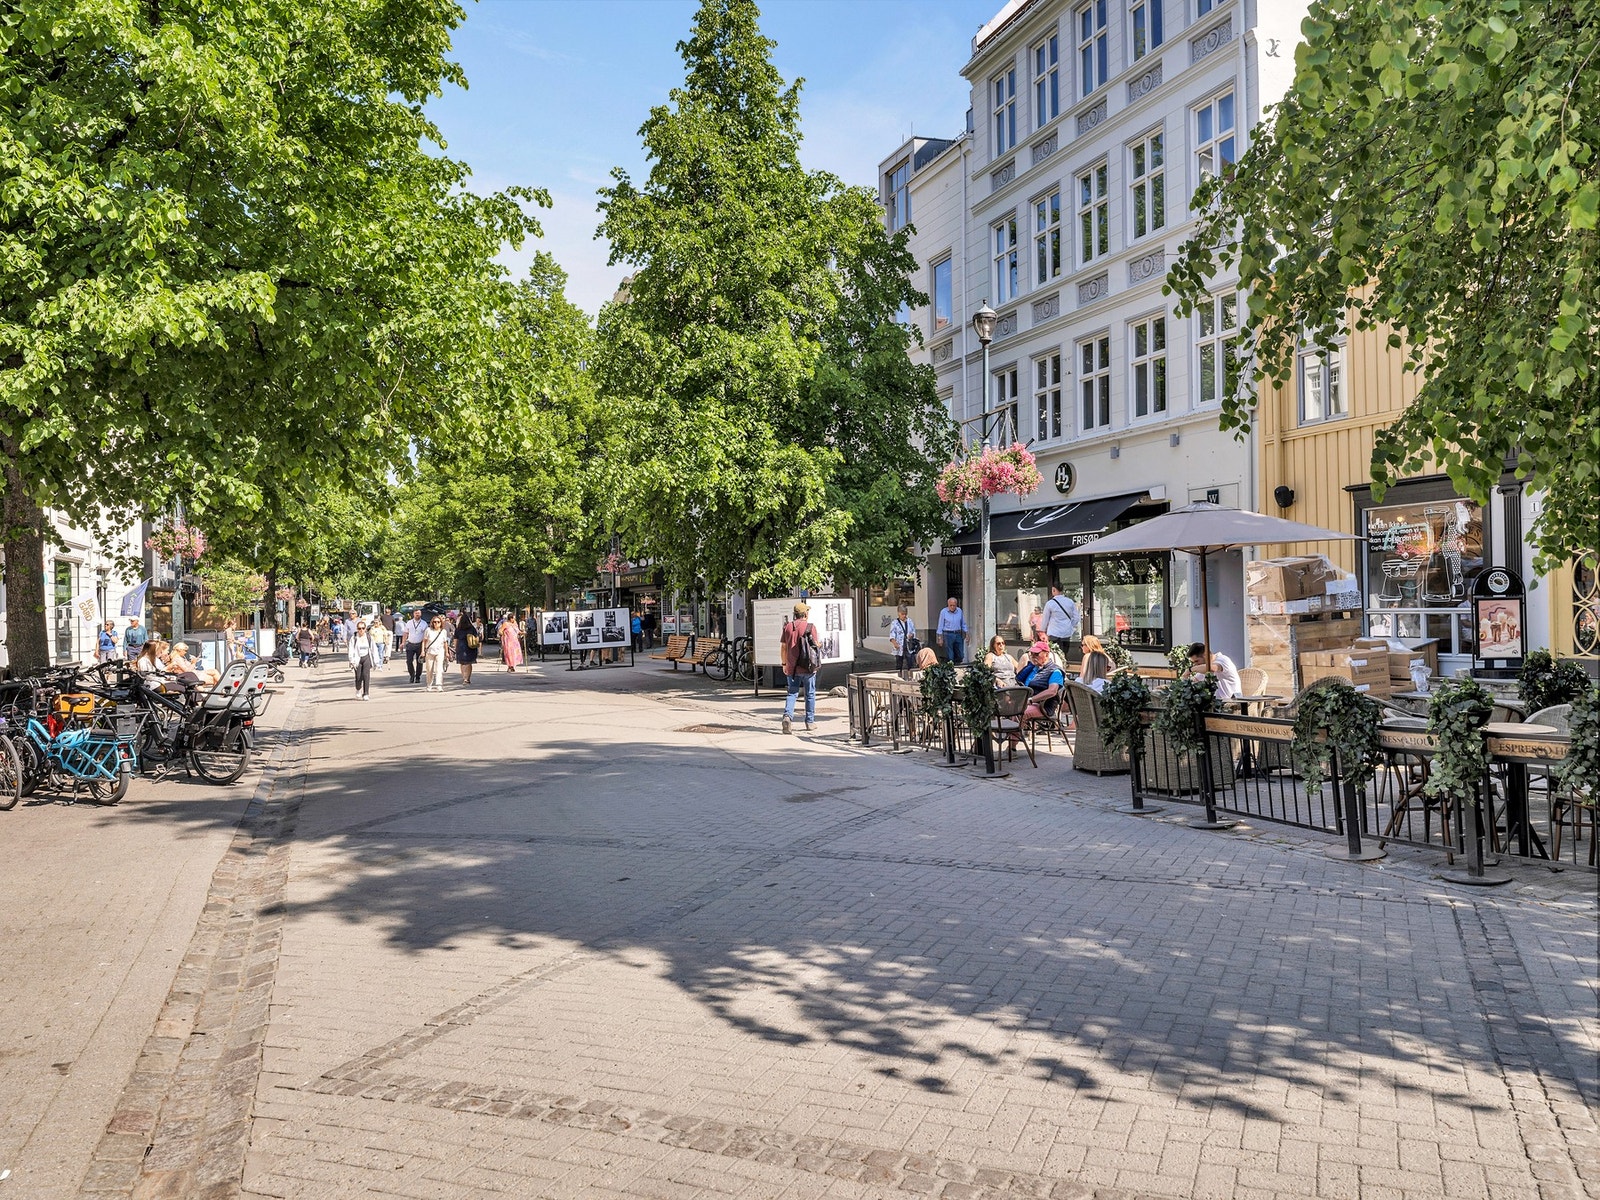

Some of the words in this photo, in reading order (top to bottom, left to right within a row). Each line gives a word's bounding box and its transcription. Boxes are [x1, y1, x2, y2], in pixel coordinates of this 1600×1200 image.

[1236, 723, 1266, 734] ESPRESSO
[1378, 735, 1409, 745] PRESSO
[1409, 737, 1439, 747] HOUE
[1499, 743, 1552, 754] ESPRESSO
